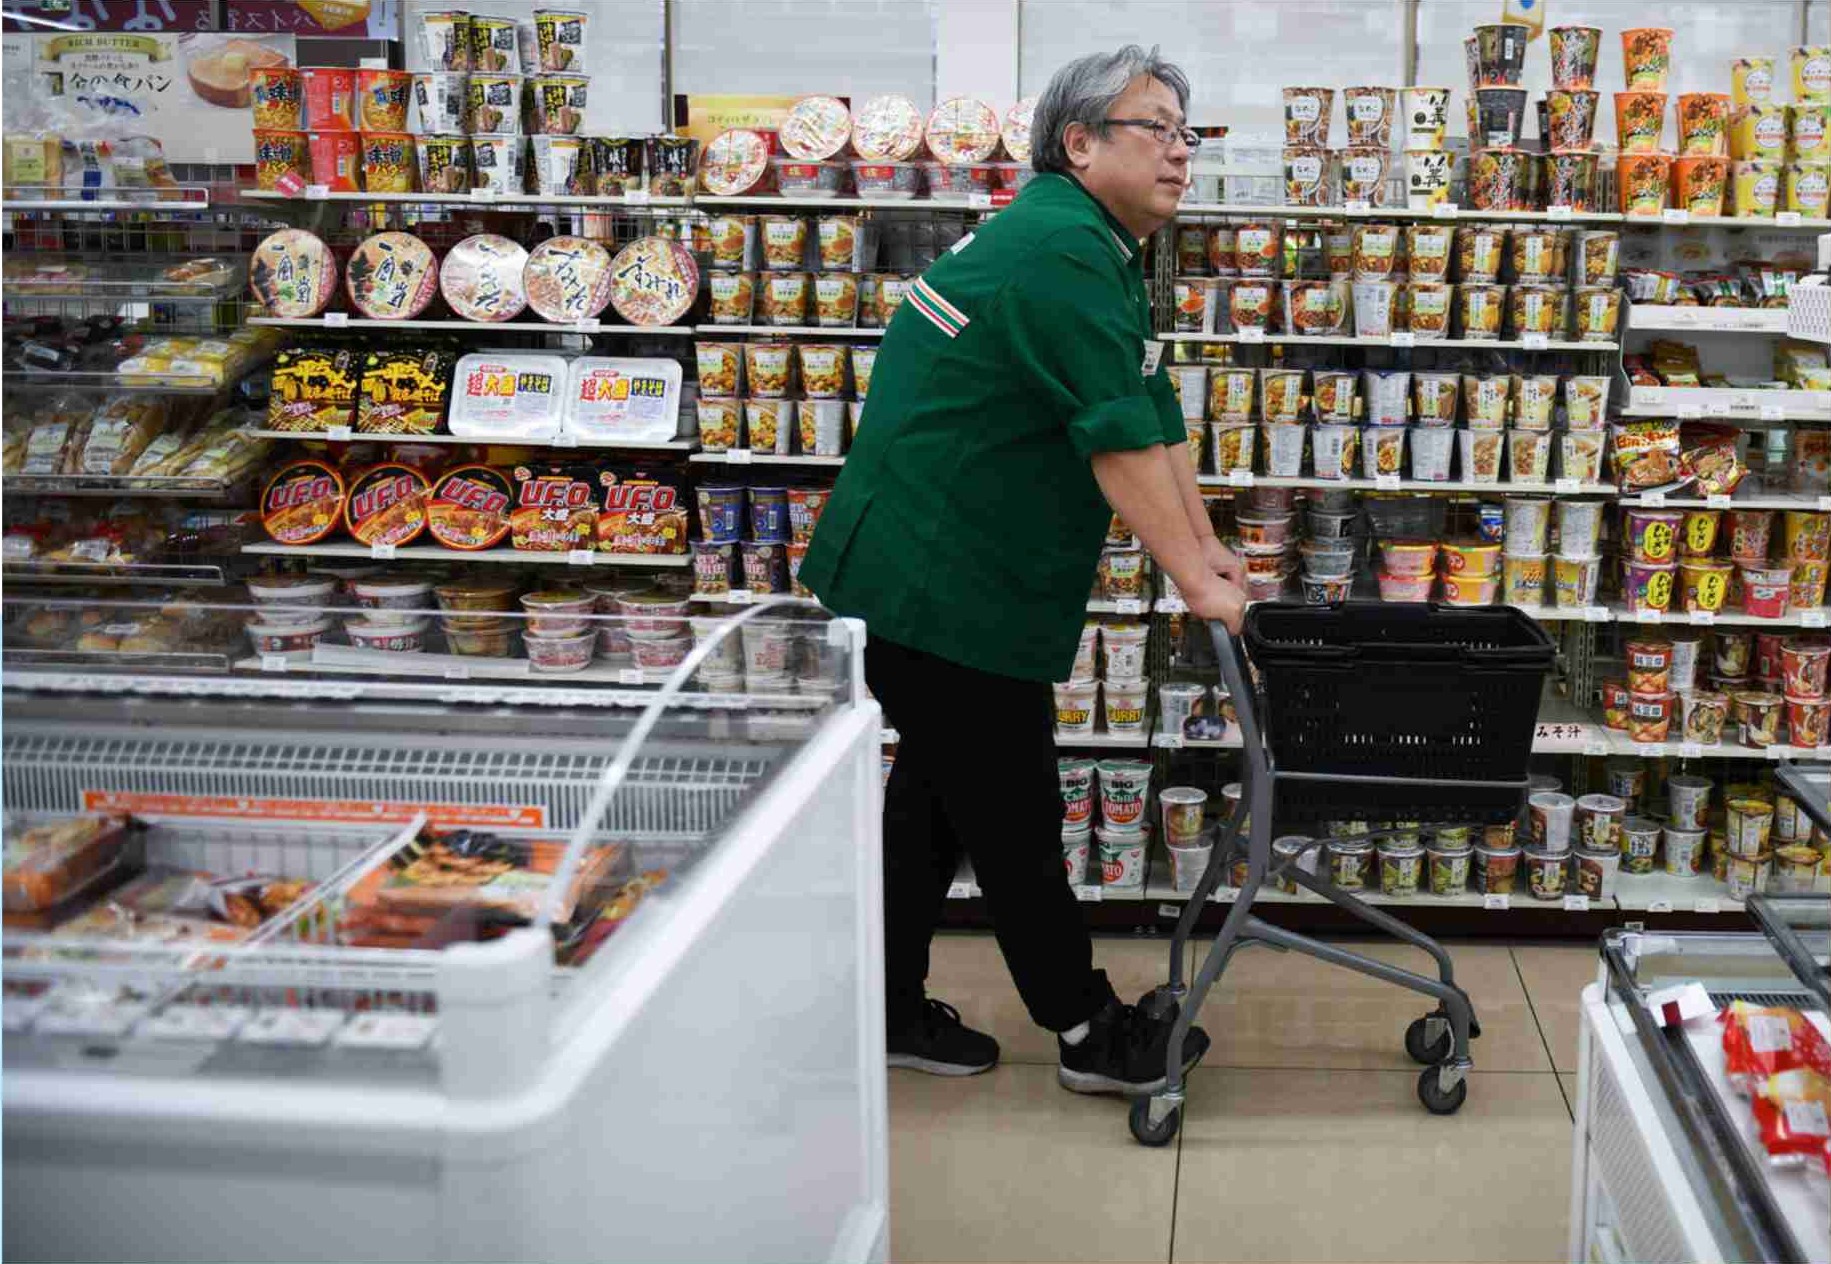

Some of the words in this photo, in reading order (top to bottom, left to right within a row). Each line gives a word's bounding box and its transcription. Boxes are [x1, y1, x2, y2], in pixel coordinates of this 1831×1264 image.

[1537, 726, 1581, 739] みそ汁
[1104, 802, 1141, 814] TOMATO
